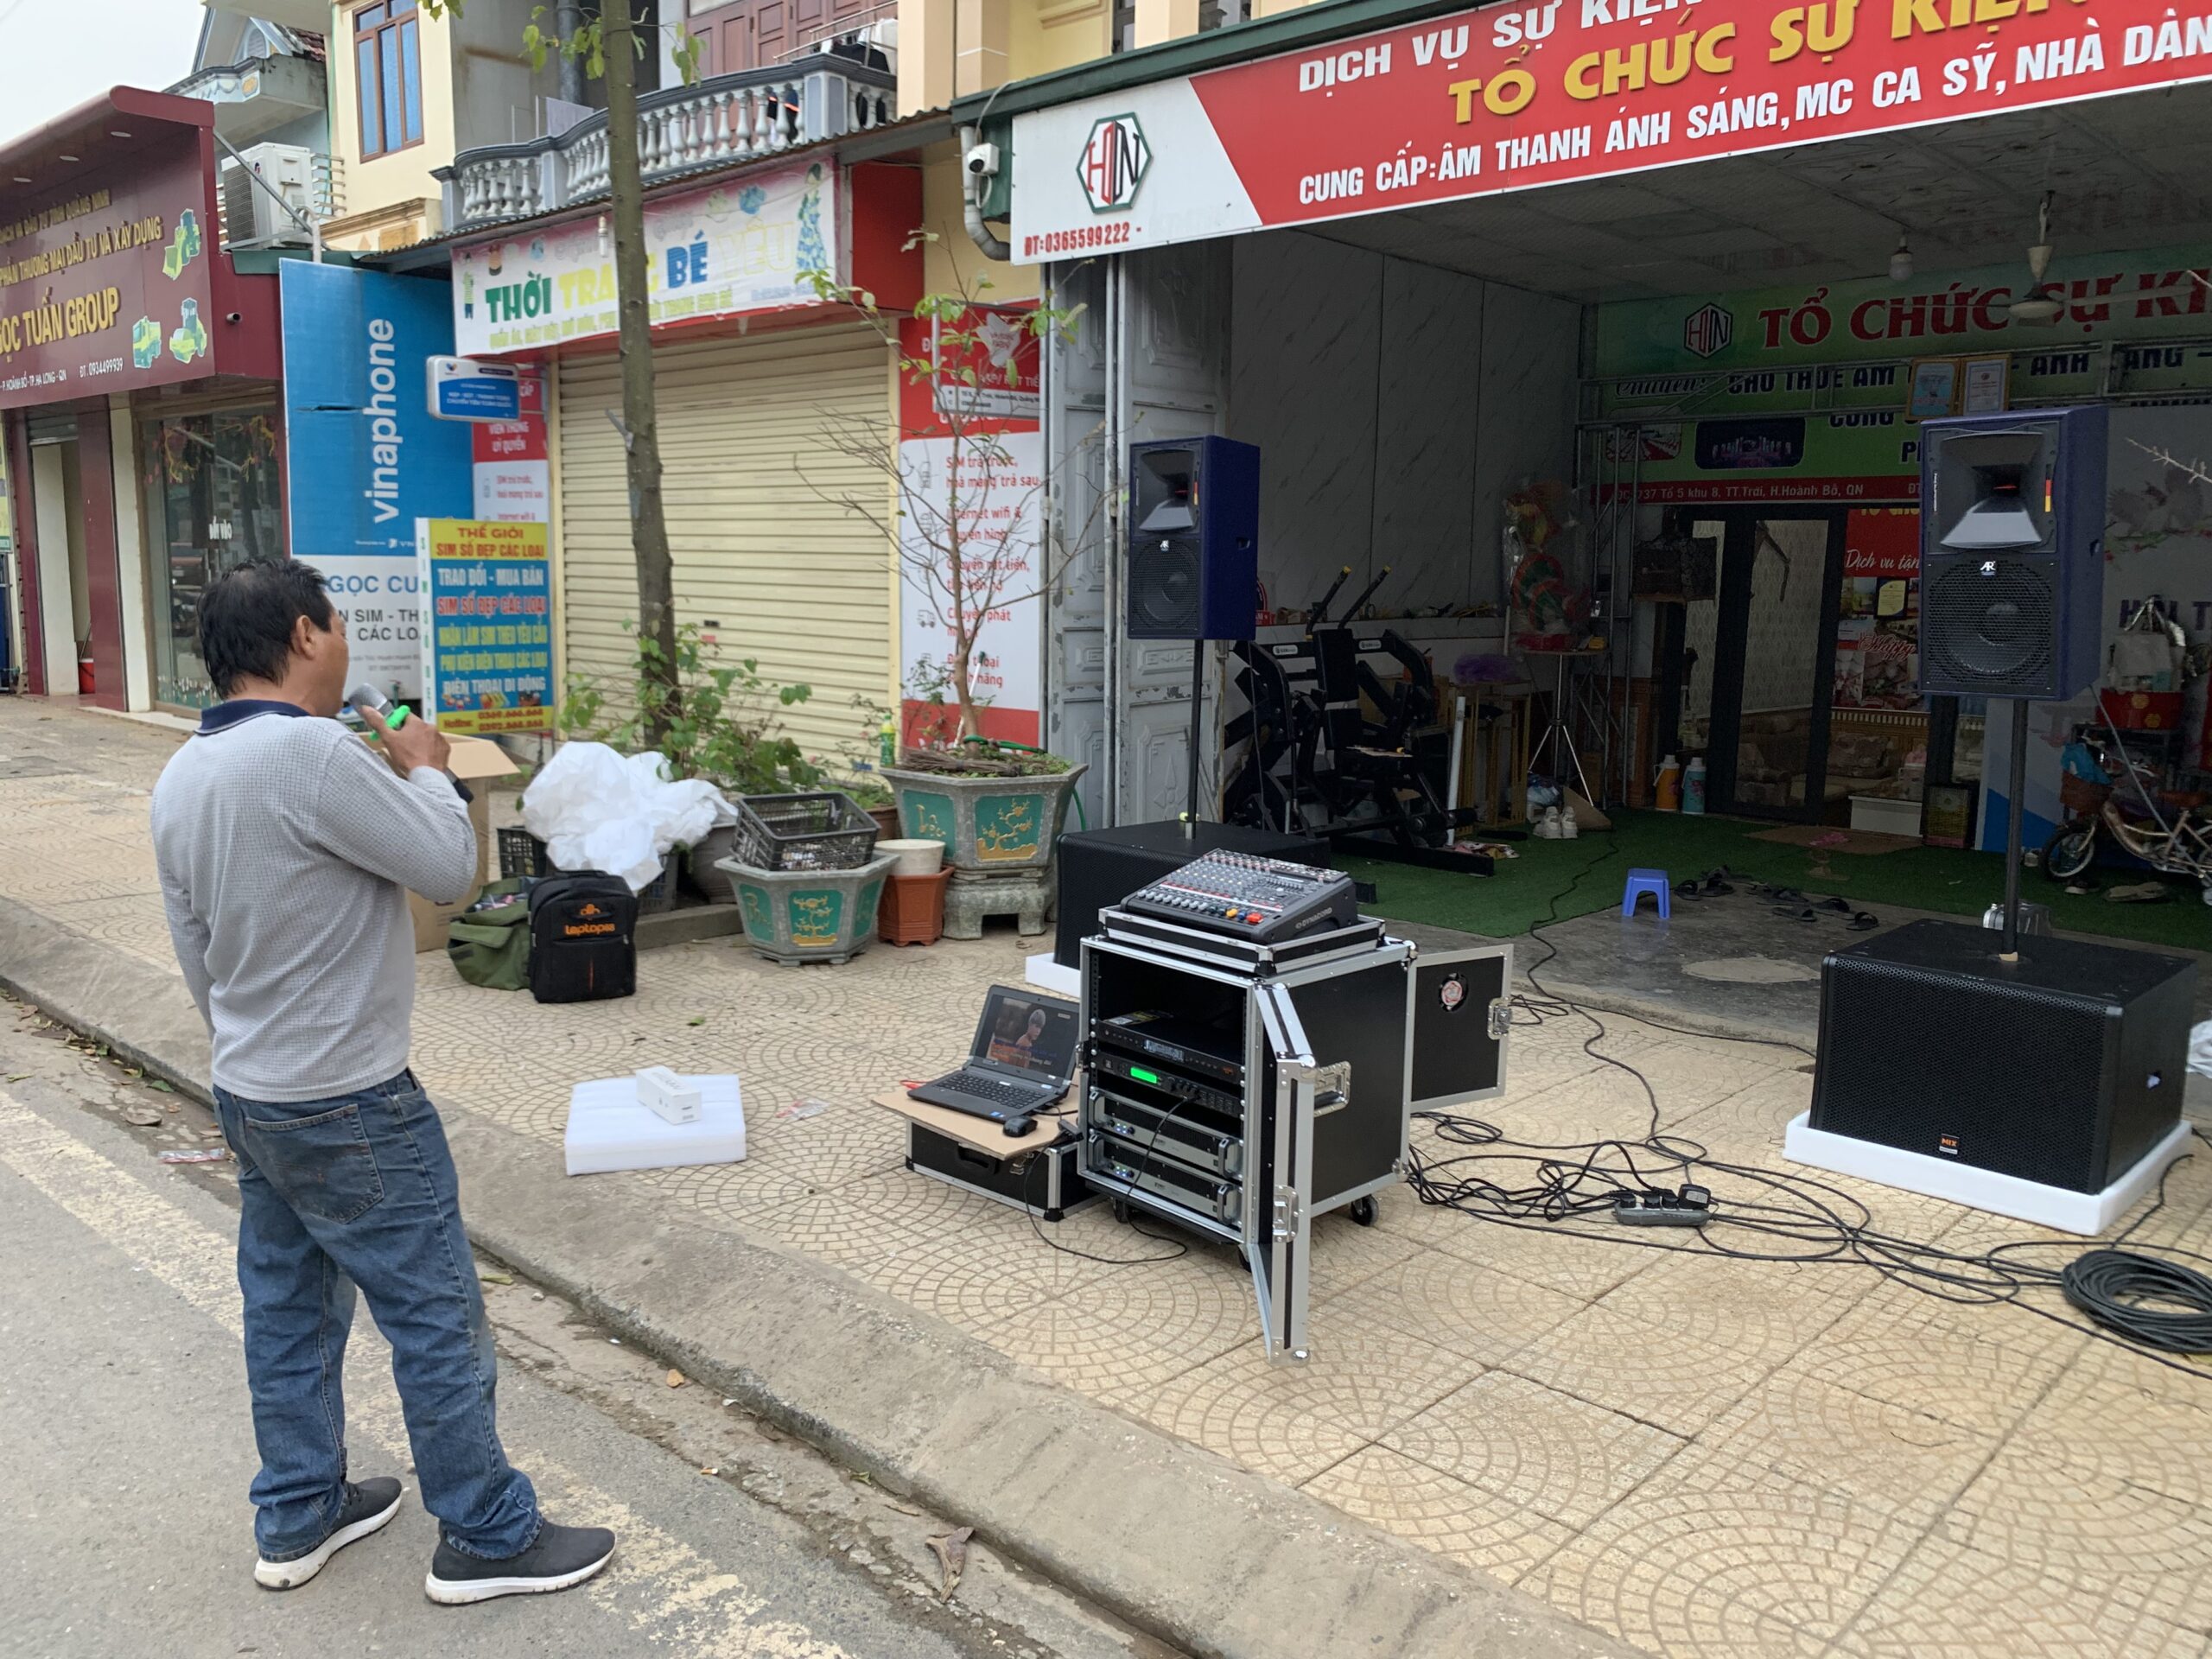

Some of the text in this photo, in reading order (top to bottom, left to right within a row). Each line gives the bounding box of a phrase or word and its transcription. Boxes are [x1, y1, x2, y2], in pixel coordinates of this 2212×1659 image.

[1300, 43, 1392, 97] DỊCH
[1412, 25, 1469, 70] VỤ
[1492, 0, 1562, 49] SỰ
[1448, 44, 1536, 124] TỔ
[1564, 8, 1736, 100] CHỨC
[1770, 0, 1859, 63] SỰ
[1300, 168, 1363, 204] CUNG
[1496, 125, 1592, 171] THANH
[1605, 106, 1671, 153] ÁNH
[1872, 67, 1922, 108] CA
[486, 270, 552, 324] THỜI
[666, 229, 709, 289] BÉ
[22, 287, 64, 347] TUẤN
[66, 287, 119, 338] GROUP
[1758, 287, 1833, 349] TỔ
[1849, 282, 2012, 340] CHỨC
[362, 319, 404, 524] vinaphone
[946, 456, 965, 468] SM
[1677, 487, 1685, 499] 5
[1688, 486, 1707, 498] khu
[1847, 482, 1865, 497] QN
[436, 543, 457, 556] SIM
[355, 609, 384, 623] SIM
[358, 625, 422, 641] CÁC LO
[437, 596, 458, 616] SIM
